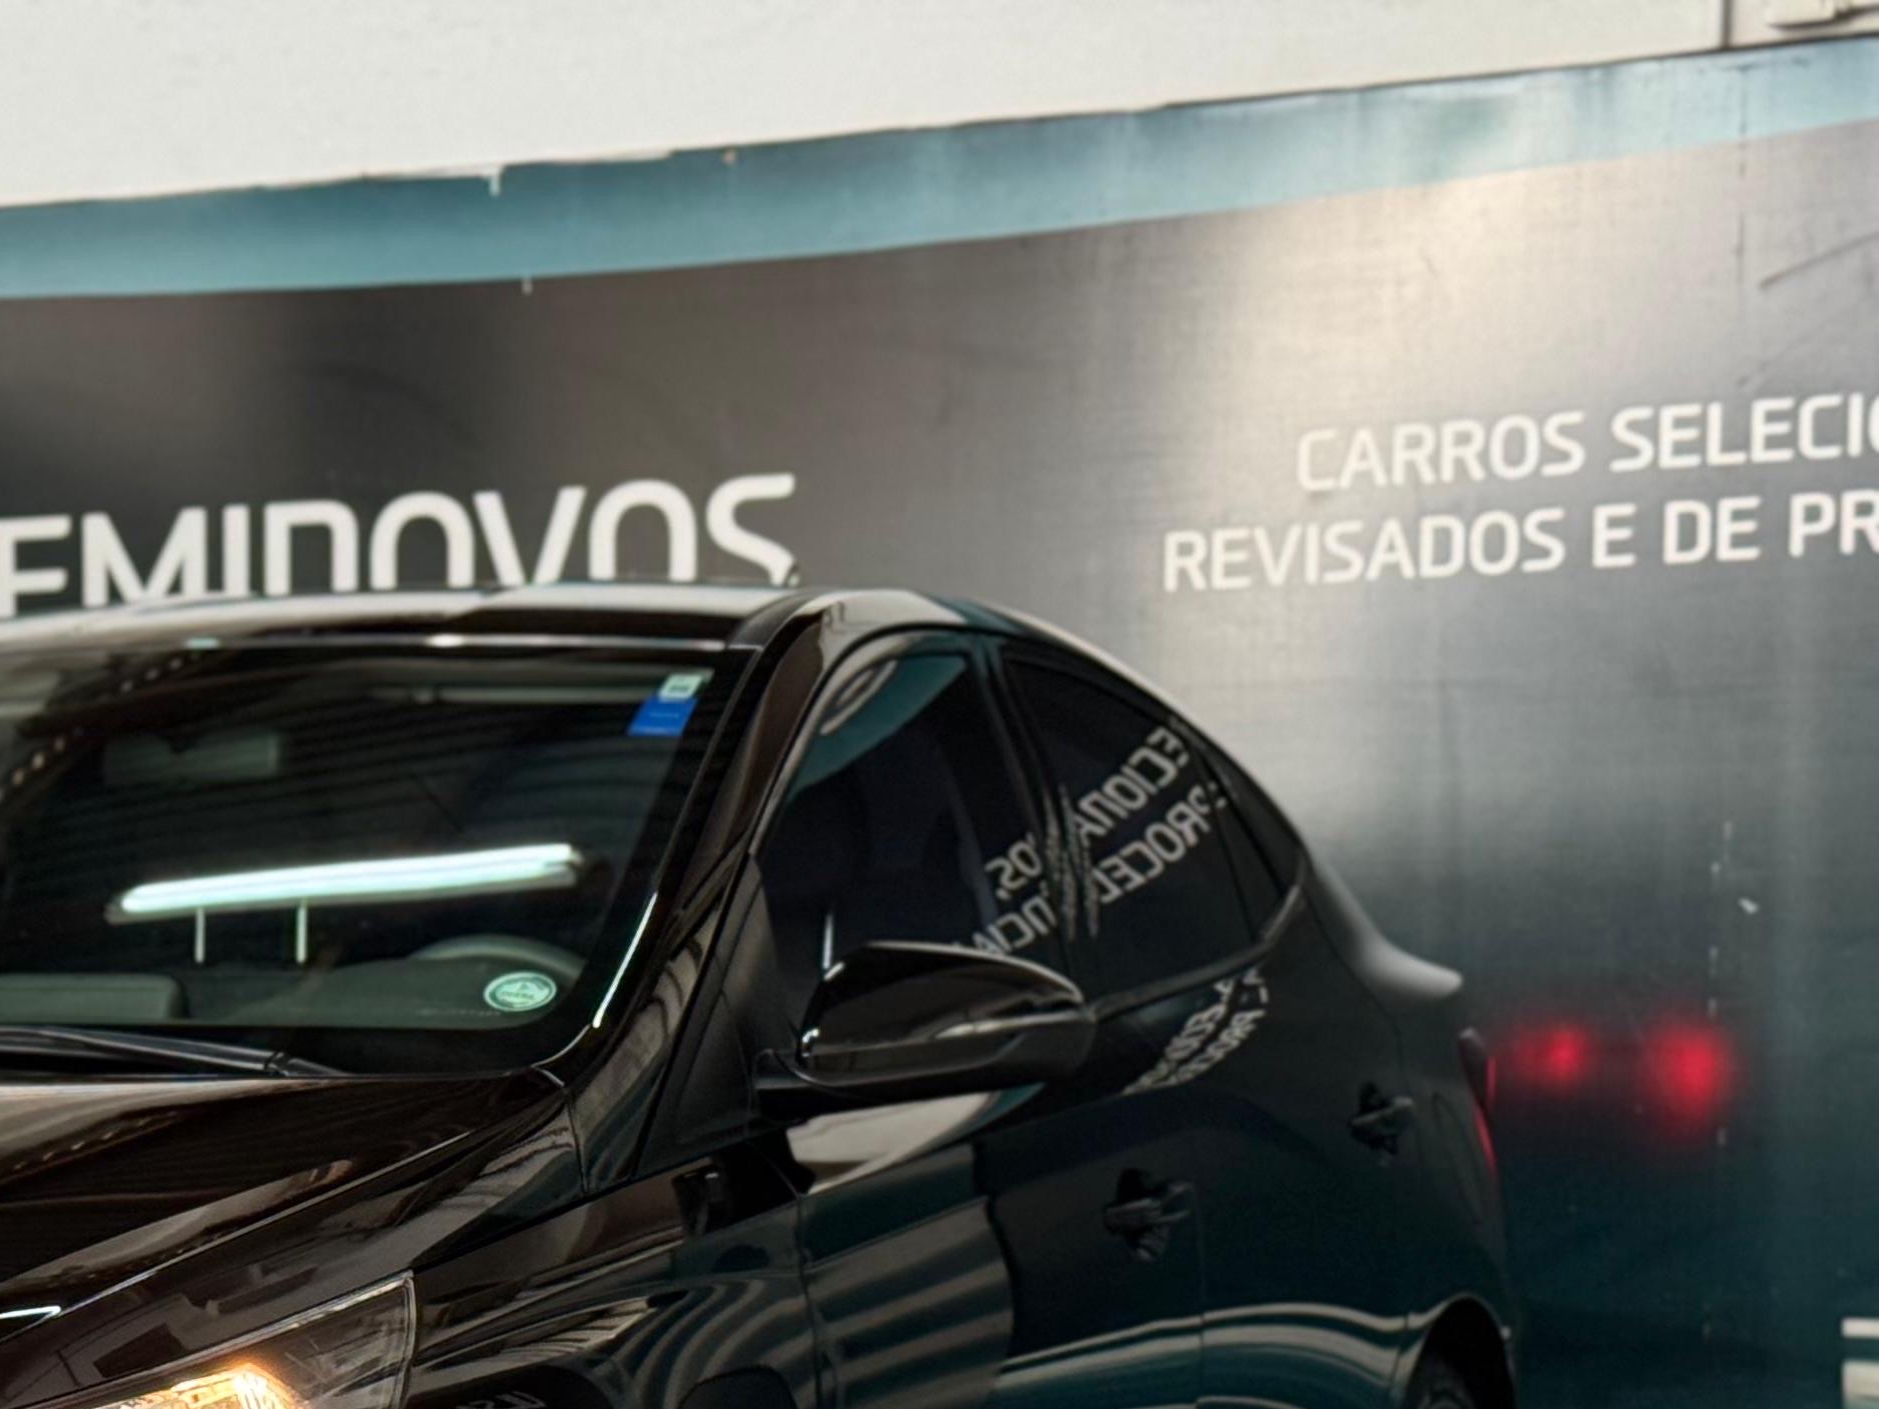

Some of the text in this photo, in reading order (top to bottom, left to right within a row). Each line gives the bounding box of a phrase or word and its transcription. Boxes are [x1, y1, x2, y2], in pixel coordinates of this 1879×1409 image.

[1296, 391, 1879, 492] CARROS SELECI
[1163, 507, 1566, 593] REVISADOS
[1592, 502, 1637, 568] E
[1662, 496, 1761, 564] DE
